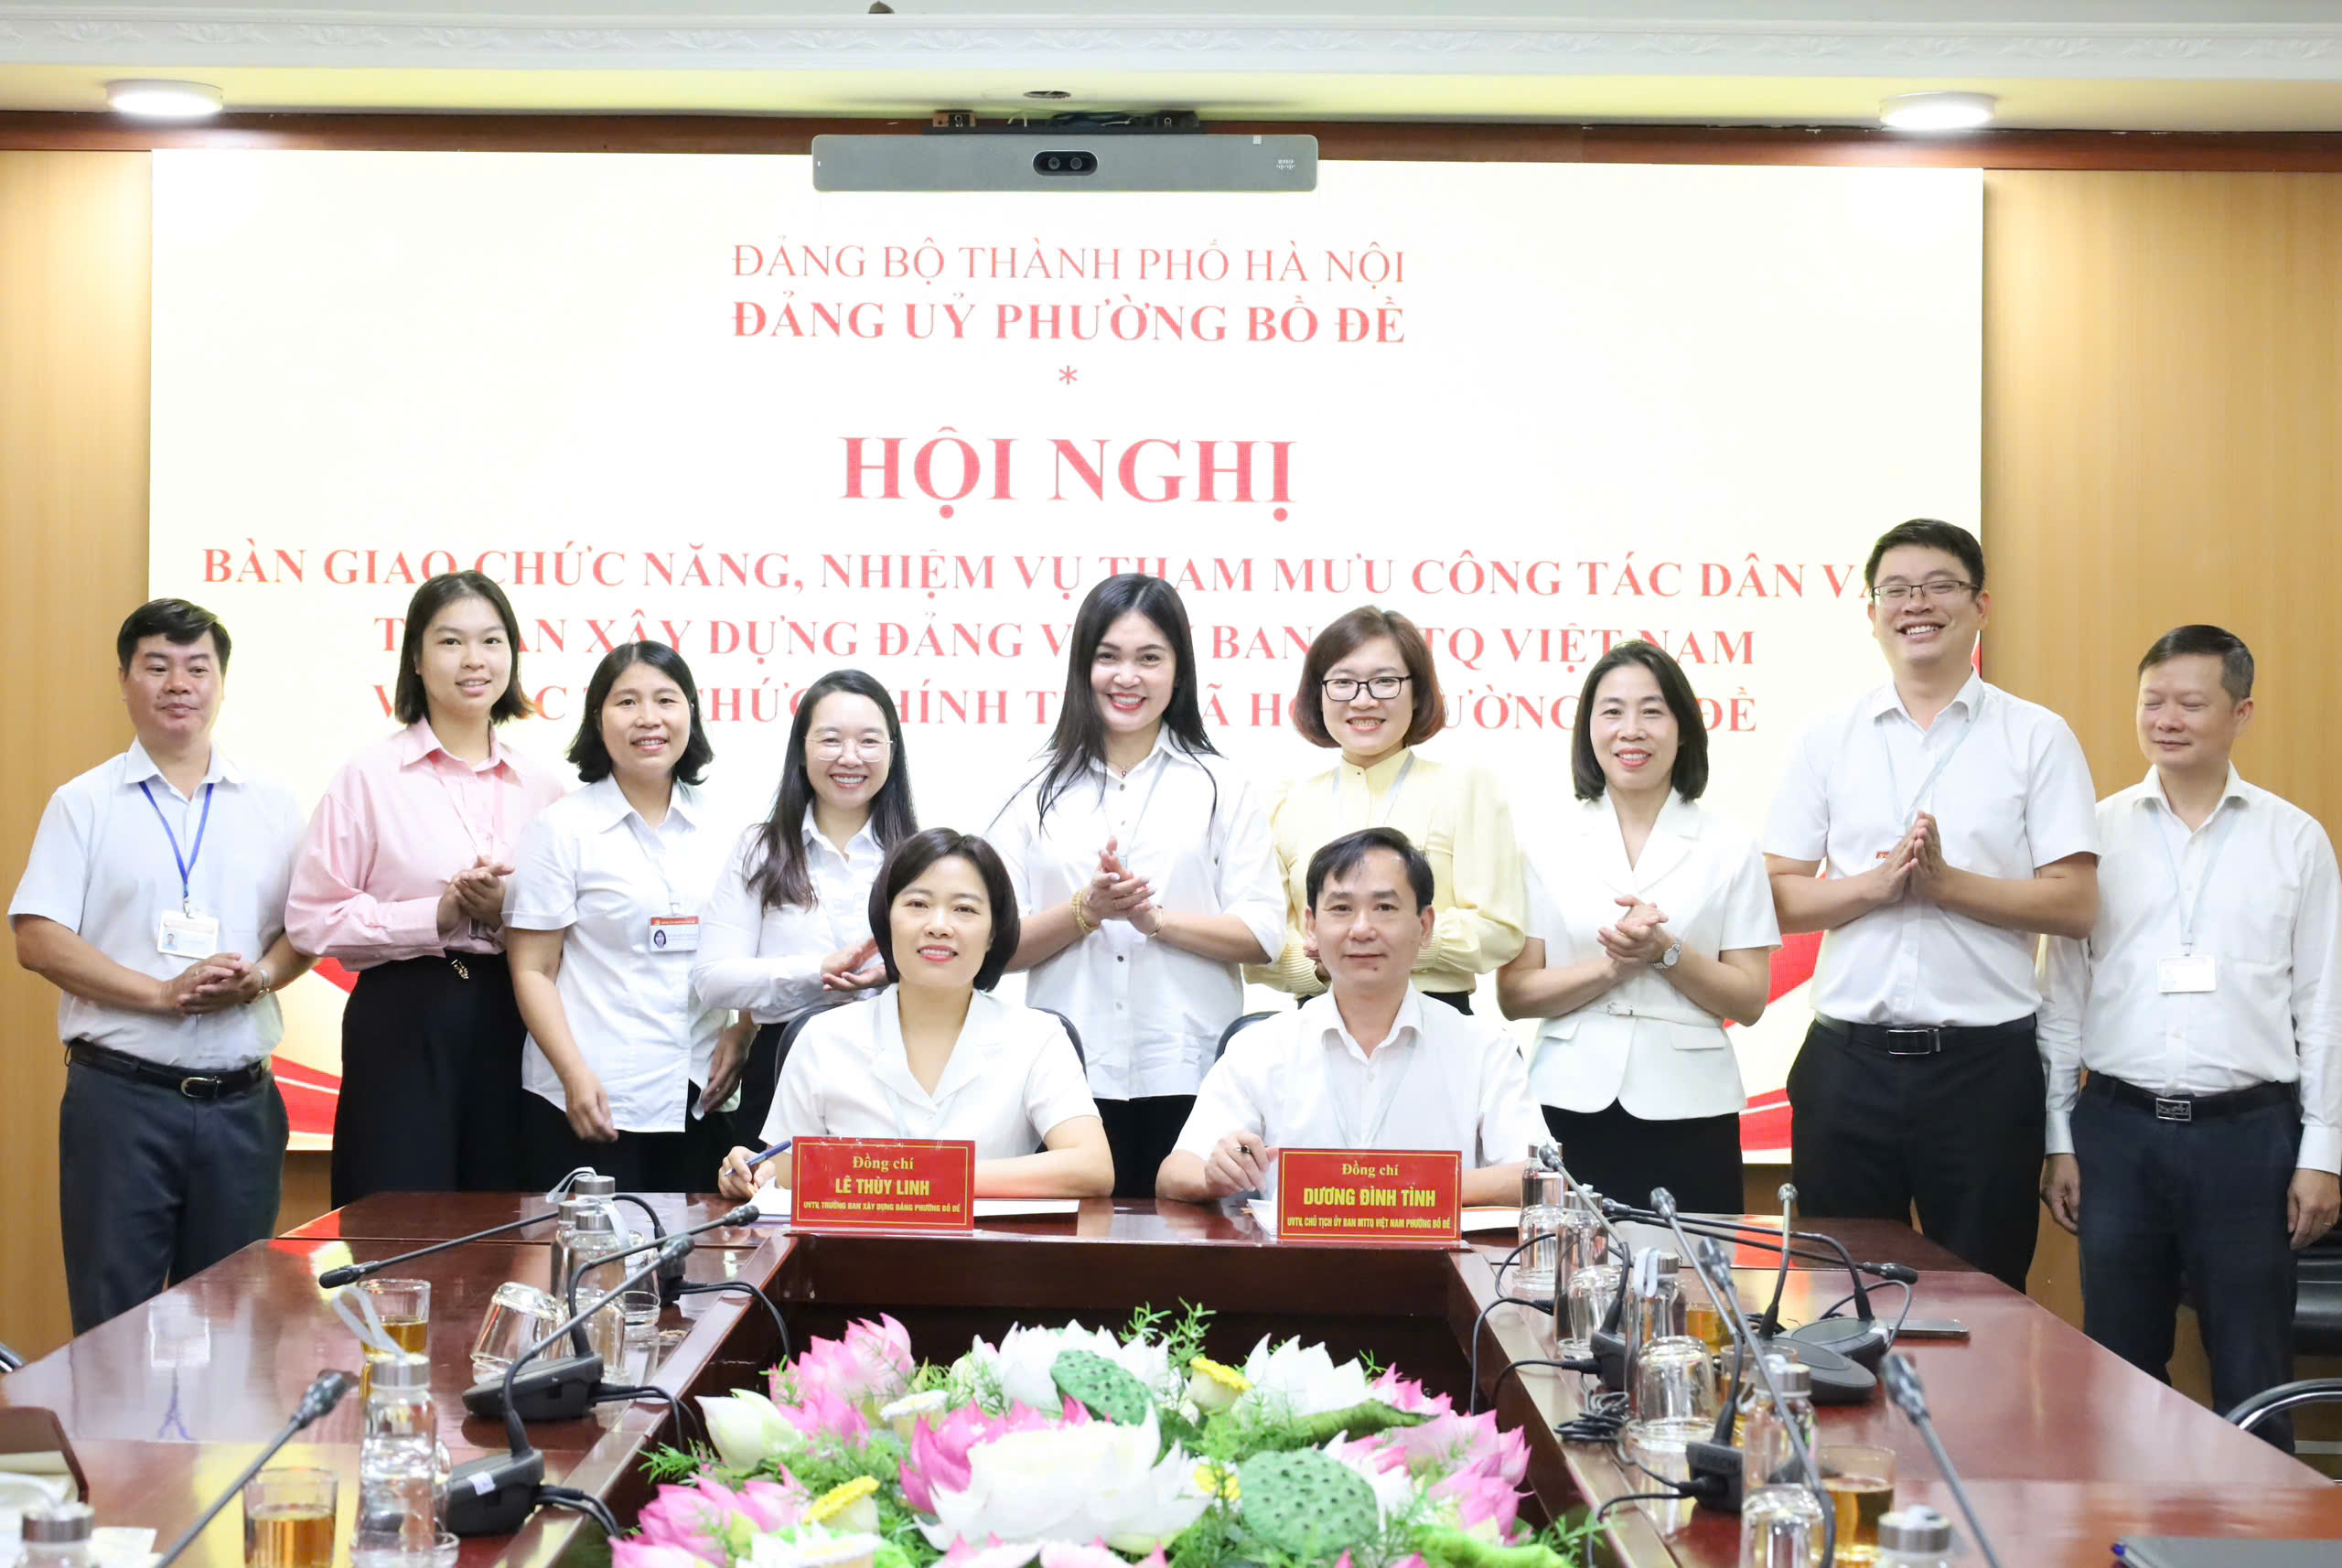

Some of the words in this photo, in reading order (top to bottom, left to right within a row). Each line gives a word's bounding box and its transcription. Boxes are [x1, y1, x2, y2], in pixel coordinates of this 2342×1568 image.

[732, 234, 865, 277] ĐẢNG
[886, 237, 944, 285] BỘ
[959, 238, 1120, 279] THÀNH
[1139, 239, 1230, 281] PHỐ
[1247, 242, 1308, 281] HÀ
[1327, 242, 1402, 289] NỘI
[732, 291, 883, 338] ĐẢNG
[906, 293, 974, 338] UỶ
[995, 295, 1226, 341] PHƯỜNG
[1249, 295, 1317, 342] BỒ
[1337, 297, 1403, 343] ĐỀ
[839, 426, 1016, 520] HỘI
[1047, 439, 1295, 522] NGHỊ
[203, 538, 306, 583] BÀN
[325, 550, 457, 584] GIAO
[475, 542, 625, 586] CHỨC
[644, 544, 803, 590] NĂNG,
[822, 549, 995, 599] NHIỆM
[1014, 556, 1080, 600] VỤ
[1273, 553, 1393, 594] MƯU
[1413, 550, 1559, 595] CÔNG
[1579, 551, 1681, 596] TÁC
[1703, 553, 1804, 597] DÂN
[586, 609, 692, 654] XÂY
[710, 616, 856, 665] DỰNG
[876, 612, 1022, 658] ĐẢNG
[1213, 626, 1310, 659] BAN
[1502, 623, 1622, 673] VIỆT
[853, 1153, 890, 1172] Đồng
[893, 1155, 915, 1169] chí
[1342, 1160, 1376, 1178] Đồng
[1380, 1164, 1399, 1176] chí
[835, 1175, 852, 1194] LÊ
[856, 1176, 892, 1195] THÙY
[897, 1179, 929, 1196] LINH
[1304, 1186, 1356, 1206] DƯƠNG
[1360, 1185, 1398, 1207] ĐÌNH
[1343, 1218, 1357, 1228] BAN
